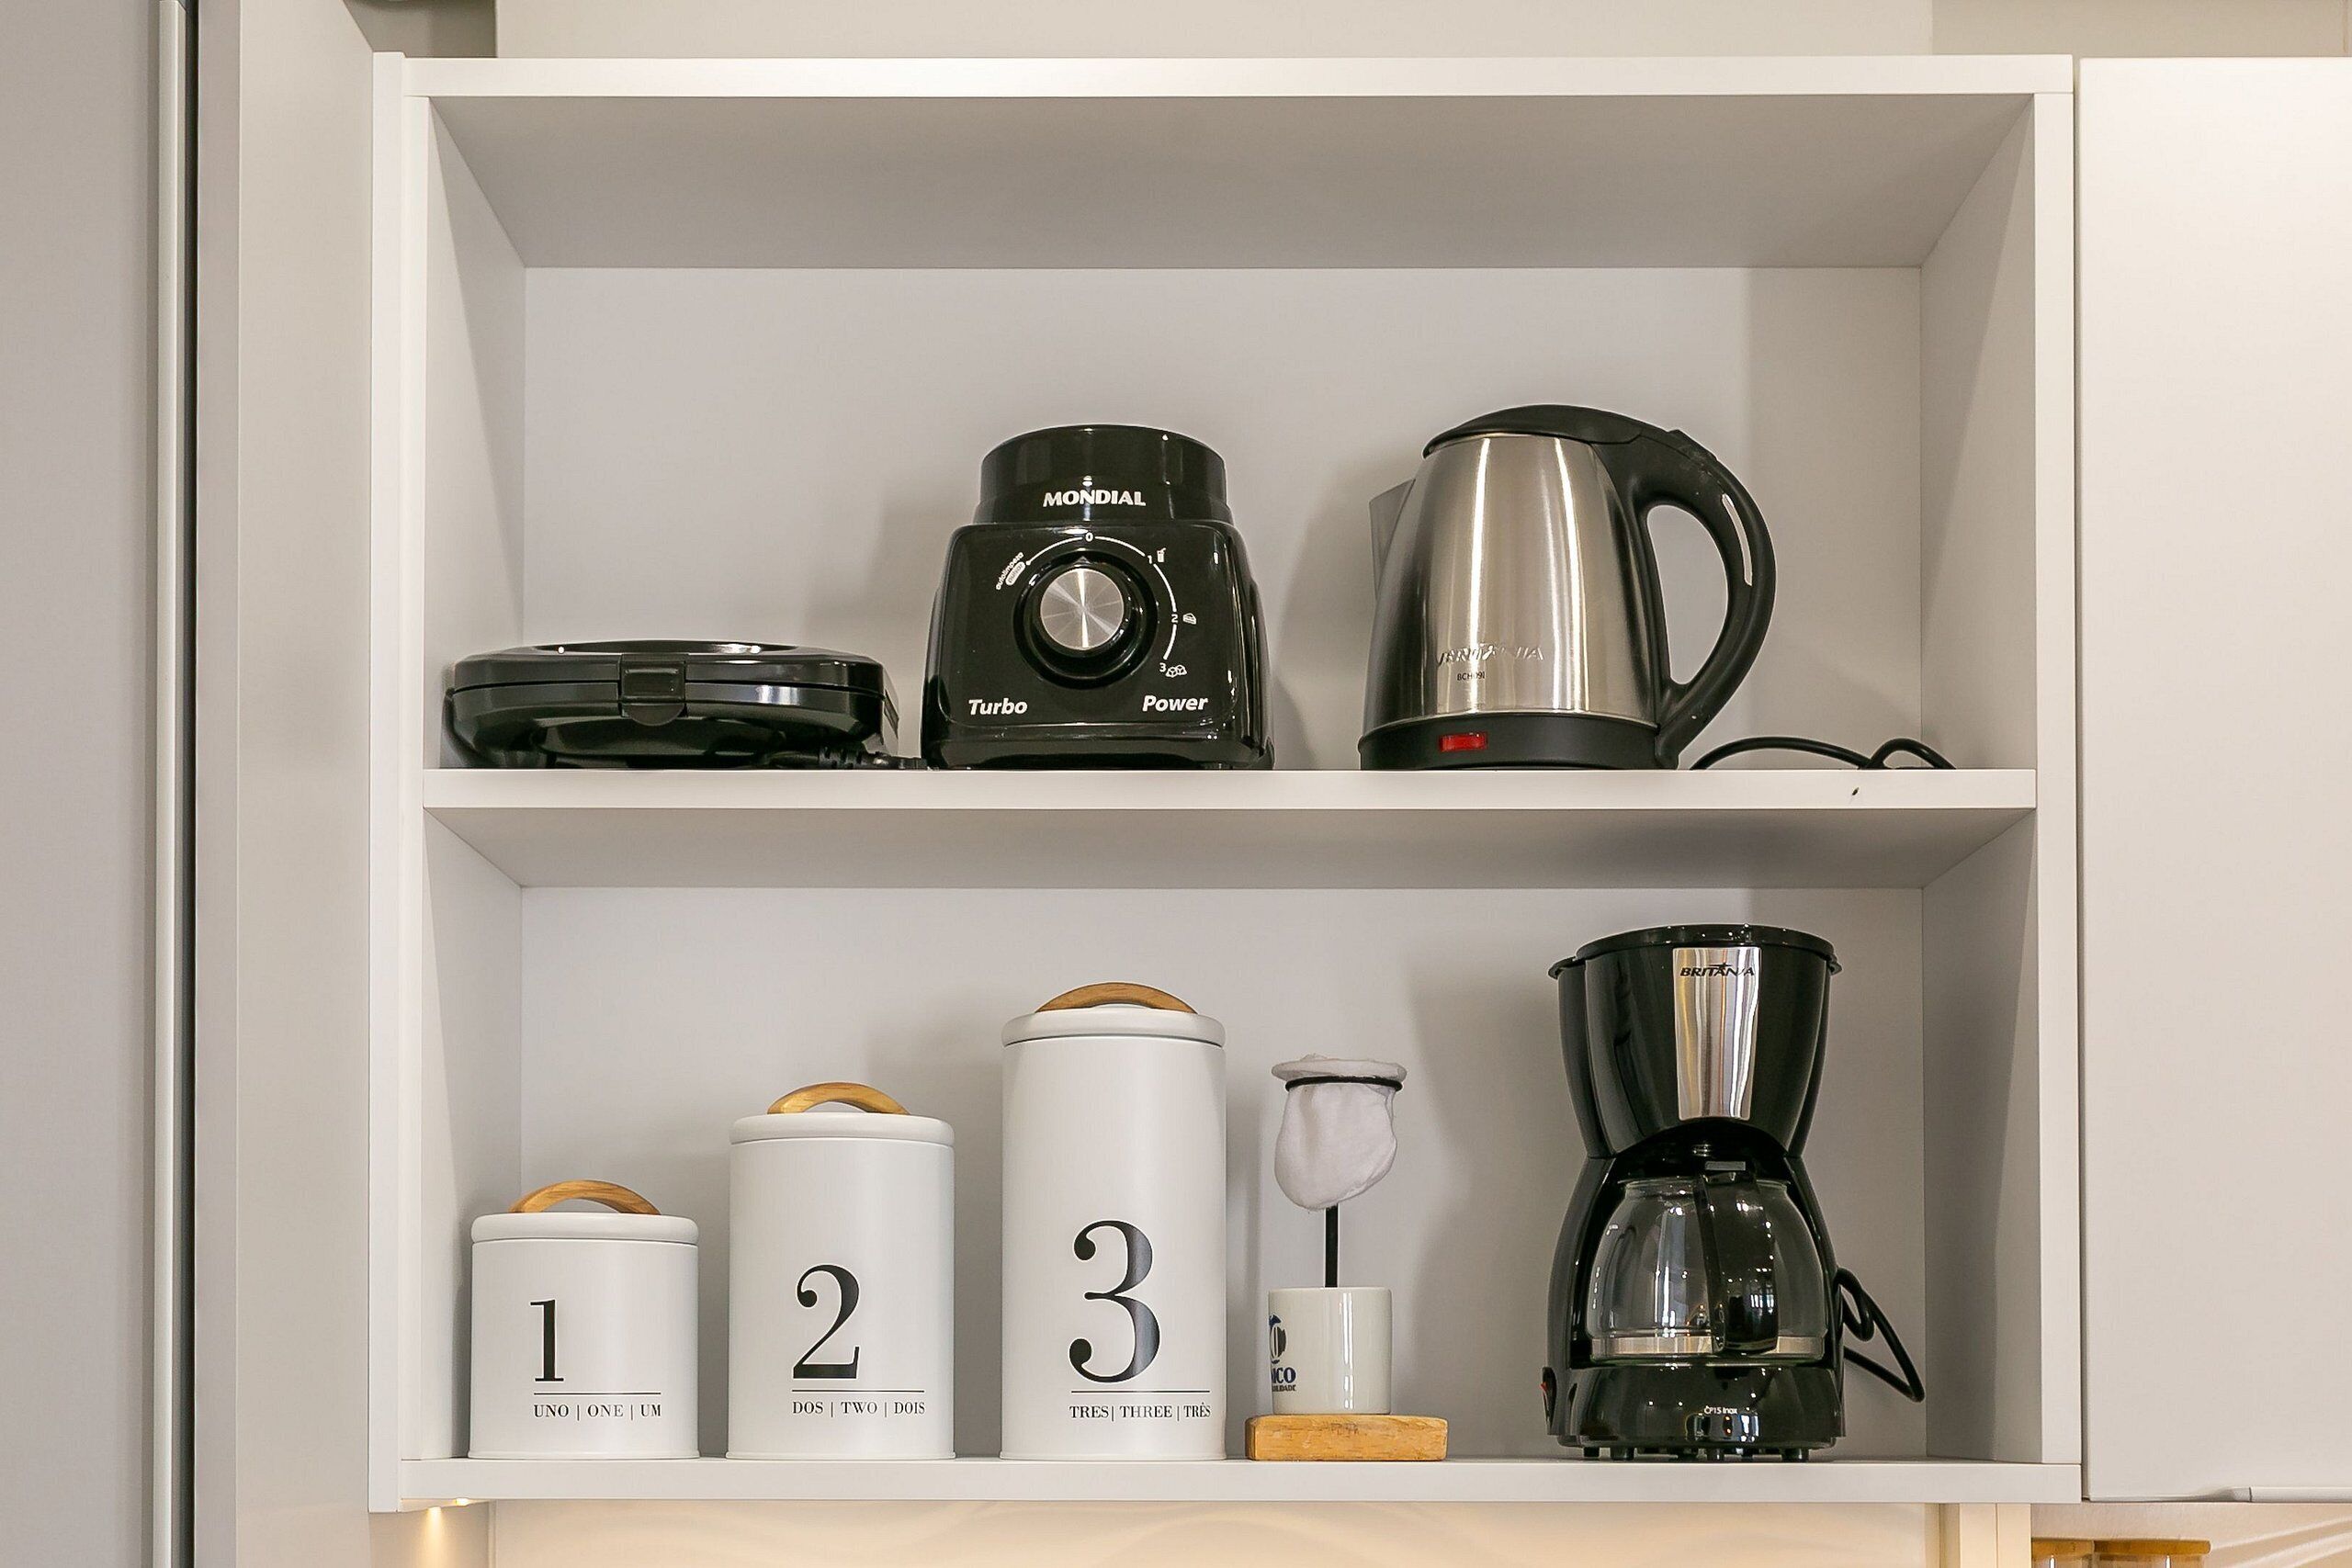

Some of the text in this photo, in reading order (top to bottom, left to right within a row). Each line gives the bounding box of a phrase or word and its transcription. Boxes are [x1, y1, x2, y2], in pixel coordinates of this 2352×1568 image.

[1043, 489, 1146, 507] MONDIAL
[1084, 531, 1093, 542] 0
[1170, 613, 1179, 623] 2
[1159, 662, 1167, 672] 3
[968, 698, 1028, 716] Turbo
[1142, 694, 1208, 712] Power
[1069, 1220, 1160, 1383] 3
[792, 1264, 860, 1380] 2
[529, 1299, 565, 1382] 1
[534, 1404, 662, 1417] UNO ONE UM
[792, 1401, 925, 1415] DOS TWO DOIS
[1069, 1402, 1211, 1418] TRES THREE TRÊS
[1722, 1406, 1738, 1415] Inox
